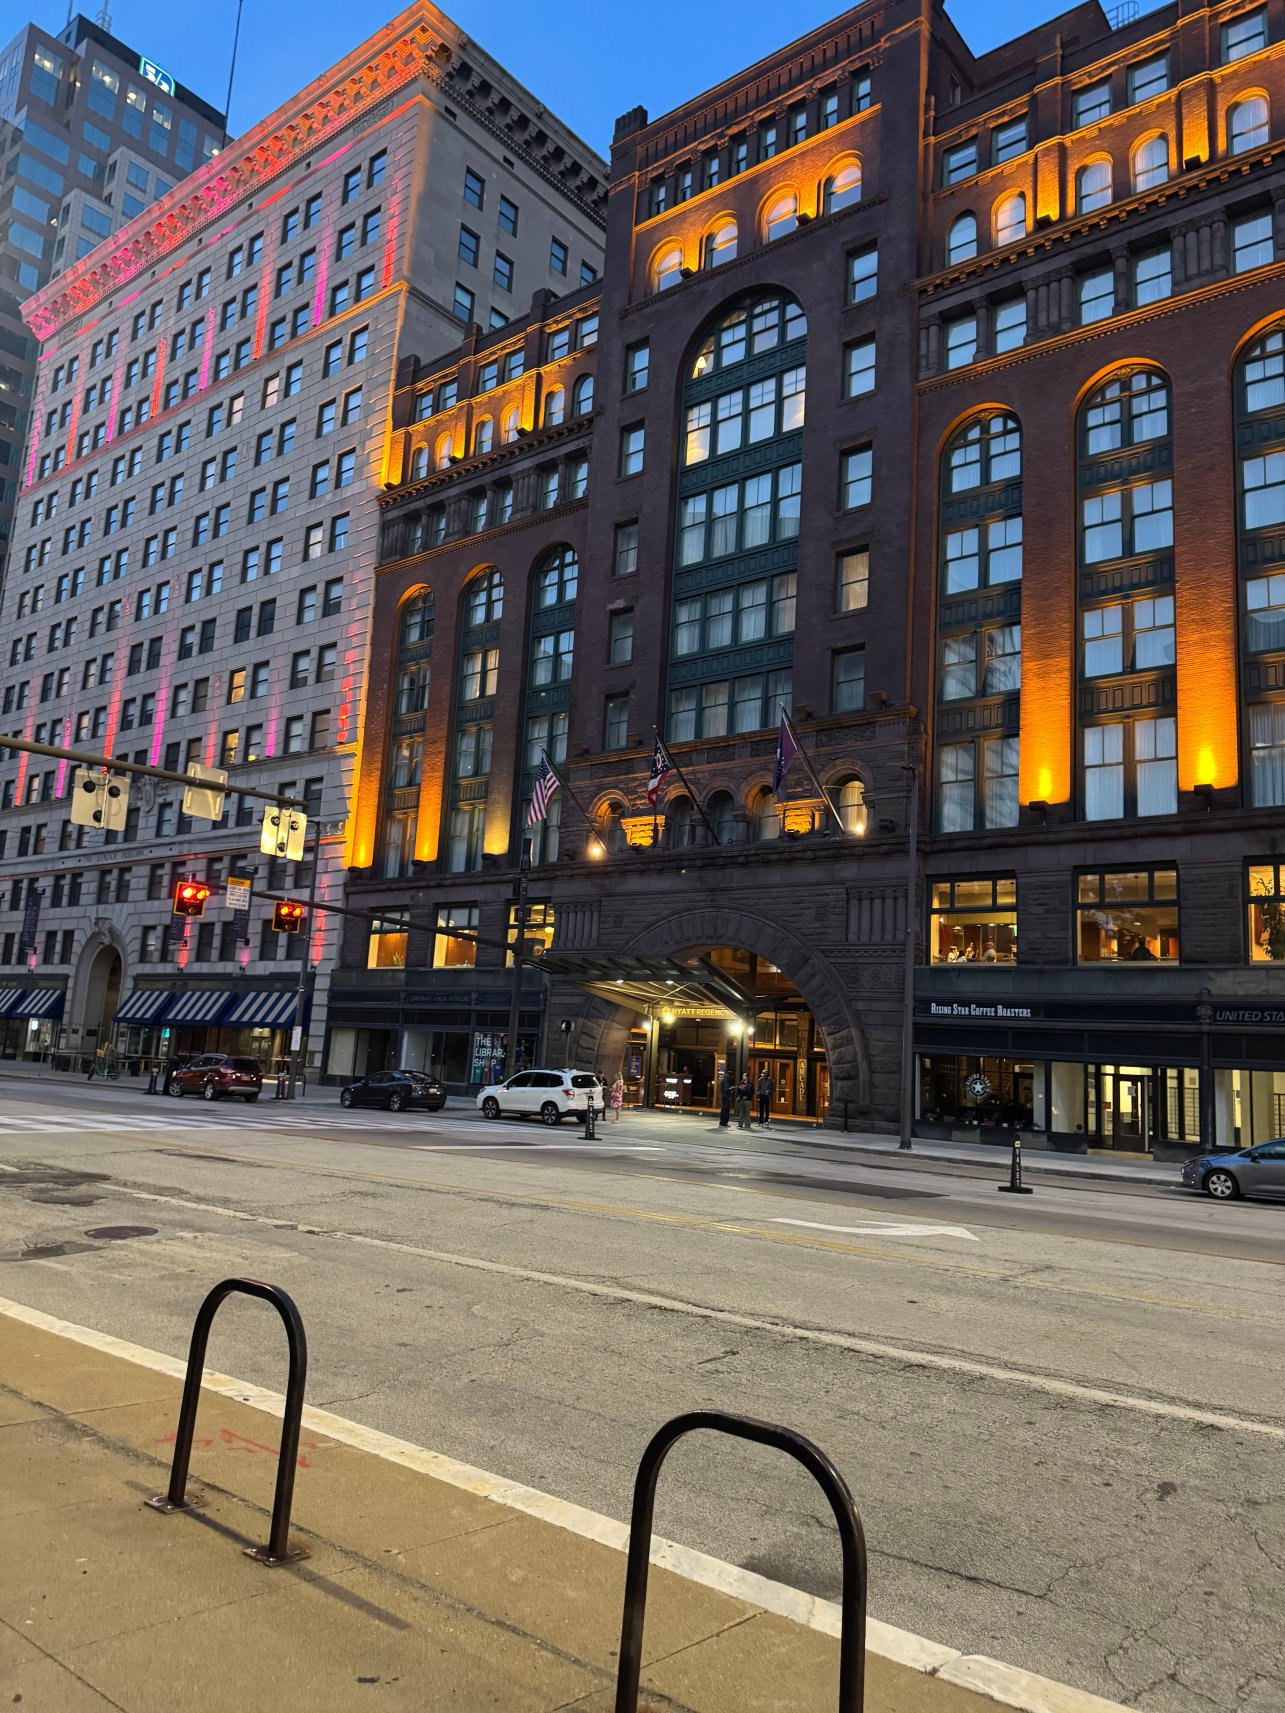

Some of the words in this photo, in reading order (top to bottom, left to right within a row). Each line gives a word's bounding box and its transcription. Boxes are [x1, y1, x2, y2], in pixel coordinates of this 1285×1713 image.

[696, 1009, 728, 1017] REGENCY
[931, 1003, 952, 1014] RISING
[952, 1003, 970, 1015] STAR
[970, 1004, 996, 1016] COFFEE
[997, 1005, 1032, 1017] ROASTERS
[1216, 1011, 1262, 1021] UNITED
[476, 1037, 492, 1047] THE
